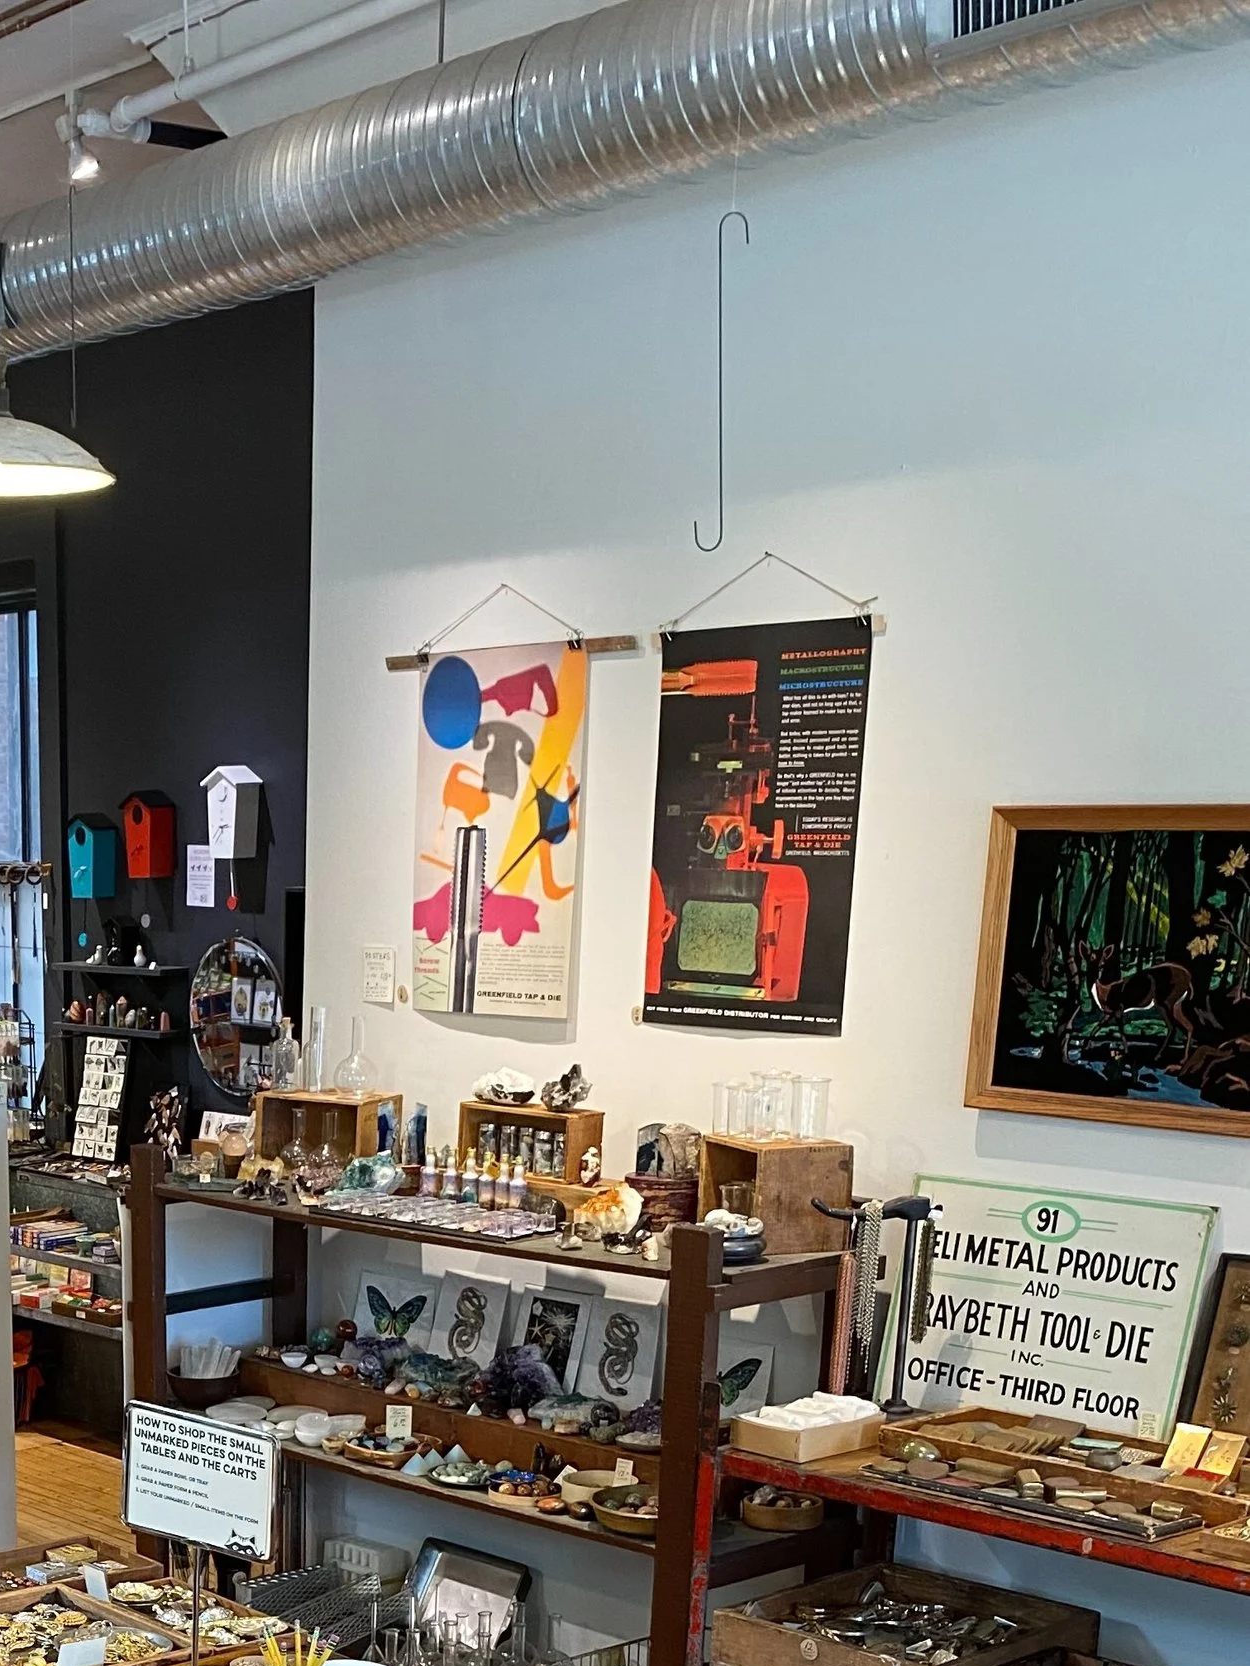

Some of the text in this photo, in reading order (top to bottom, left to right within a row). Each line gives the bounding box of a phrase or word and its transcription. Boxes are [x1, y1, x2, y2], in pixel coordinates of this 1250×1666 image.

[781, 648, 867, 660] METALLOGRAPHY
[780, 664, 865, 675] MACROSTRUCTURE
[778, 679, 864, 691] MICROSTRUCTURE
[476, 990, 522, 1000] GREENFIELD
[547, 994, 562, 1002] DIE
[683, 1006, 723, 1016] GREENFIELD
[724, 1010, 768, 1019] DISTRIBUTOR
[1036, 1207, 1060, 1234] 91
[964, 1232, 1050, 1275] METAL
[1056, 1247, 1180, 1293] PRODUCTS
[1022, 1280, 1060, 1299] AND
[1040, 1310, 1092, 1354] TOOL
[1105, 1322, 1154, 1364] DIE
[1010, 1350, 1044, 1368] INC.
[907, 1357, 984, 1392] OFFICE
[998, 1374, 1066, 1406] THIRD
[1072, 1388, 1140, 1420] FLOOR
[137, 1414, 263, 1455] HOW TO SHOP THE SMALL
[134, 1428, 265, 1469] UNMARKED PIECES ON THE
[141, 1442, 256, 1480] TABLES AND THE CARTS
